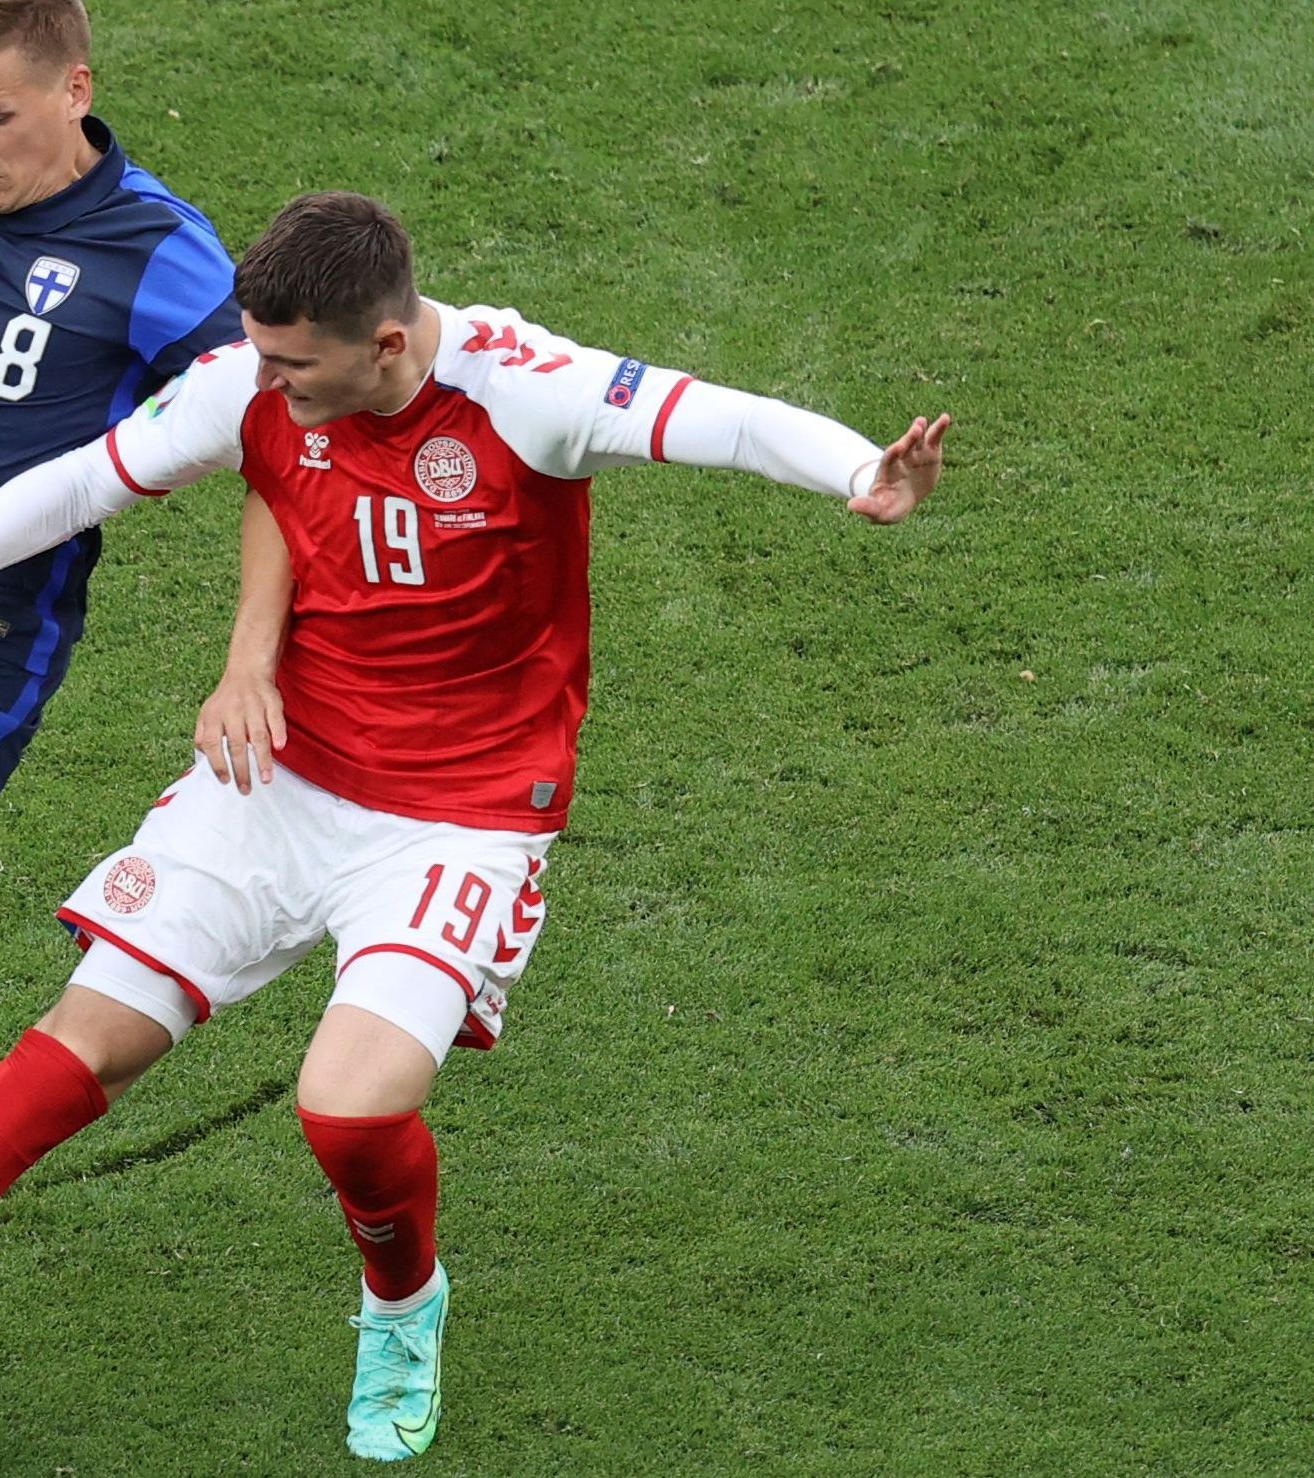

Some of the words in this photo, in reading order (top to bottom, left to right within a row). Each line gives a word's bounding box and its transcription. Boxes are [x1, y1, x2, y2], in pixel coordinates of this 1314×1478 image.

[428, 457, 464, 479] DBU
[353, 494, 426, 586] 19
[113, 870, 147, 901] DBU
[408, 863, 492, 953] 19
